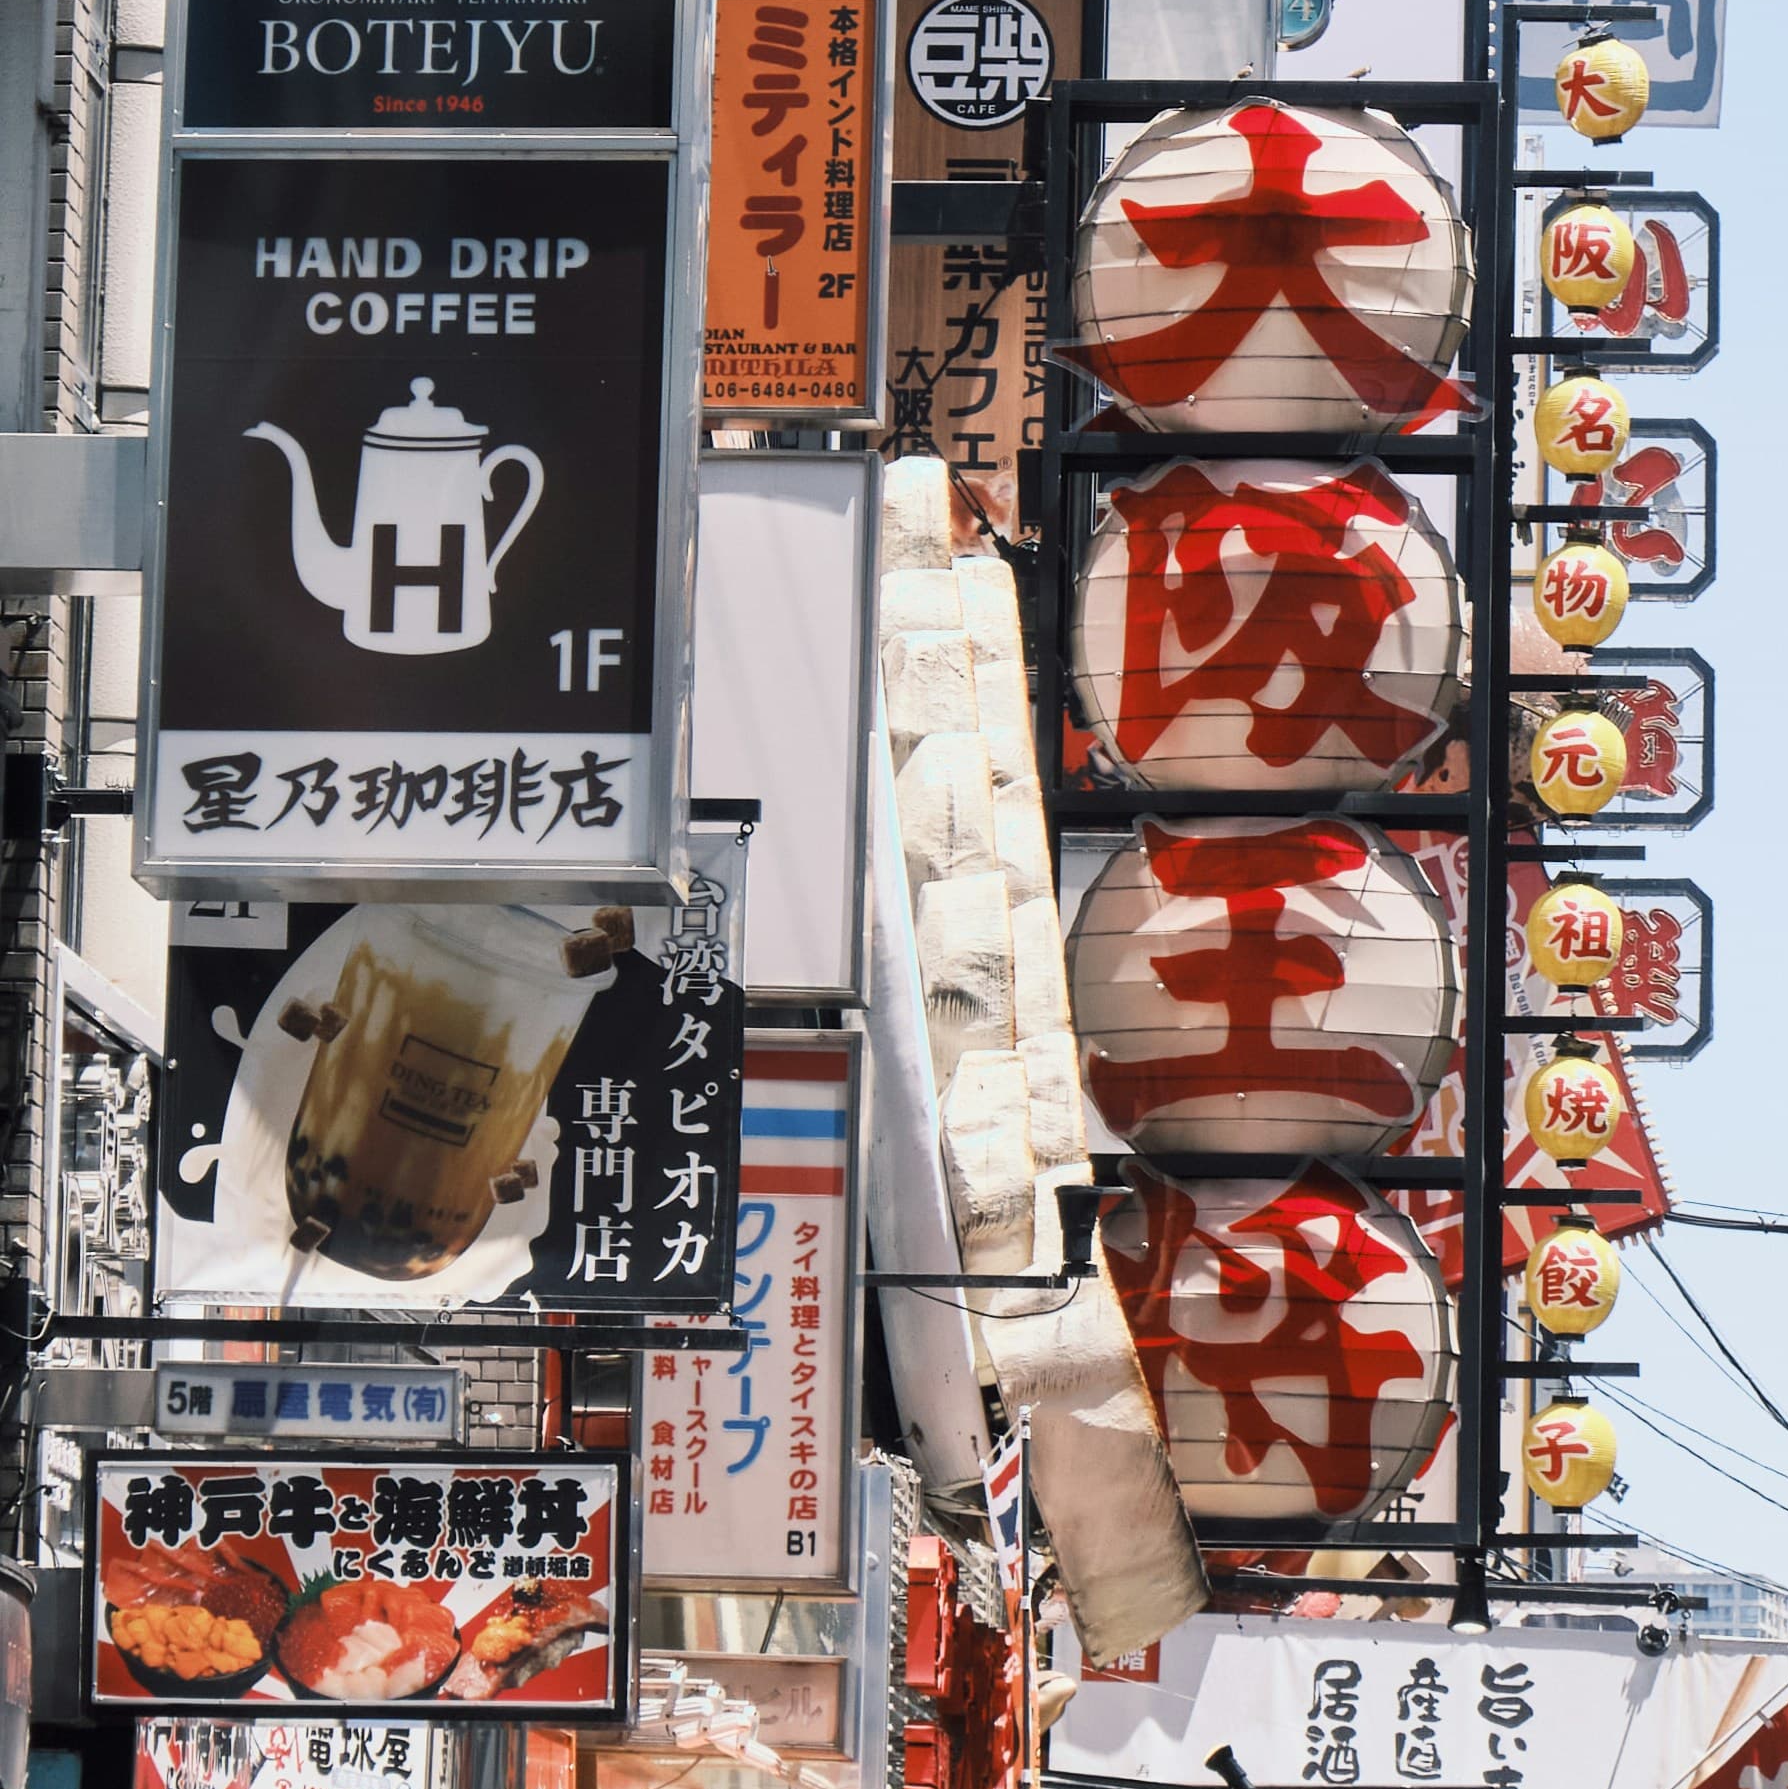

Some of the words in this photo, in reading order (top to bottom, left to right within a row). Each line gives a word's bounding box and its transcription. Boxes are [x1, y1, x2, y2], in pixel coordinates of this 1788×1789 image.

[257, 18, 604, 87] BOTEJYU
[373, 94, 428, 115] Since
[435, 94, 485, 114] 1946
[823, 5, 860, 252] 本格インド料理店
[957, 103, 997, 115] CAFE
[740, 5, 811, 331] ミティラー
[255, 237, 423, 280] HAND
[450, 237, 590, 280] DRIP
[818, 273, 857, 299] 2F
[304, 292, 537, 335] COFFEE
[704, 328, 745, 341] DIAN
[704, 343, 799, 355] STAURANT
[803, 343, 817, 355] &
[822, 343, 857, 355] BAR
[370, 523, 466, 634] H
[550, 628, 625, 693] 1F
[180, 747, 632, 844] 星乃珈琲店
[660, 870, 726, 1282] 台湾タピオカ
[568, 1076, 639, 1282] 専門店
[786, 1221, 821, 1521] タイ料理とタイスキの店
[647, 1420, 675, 1516] 食材店
[122, 1475, 592, 1549] 神戸牛と海鮮丼
[787, 1533, 817, 1557] B1
[333, 1552, 496, 1579] にくあんど
[502, 1555, 591, 1579] 道頓堀店
[1396, 1657, 1450, 1781] 産直
